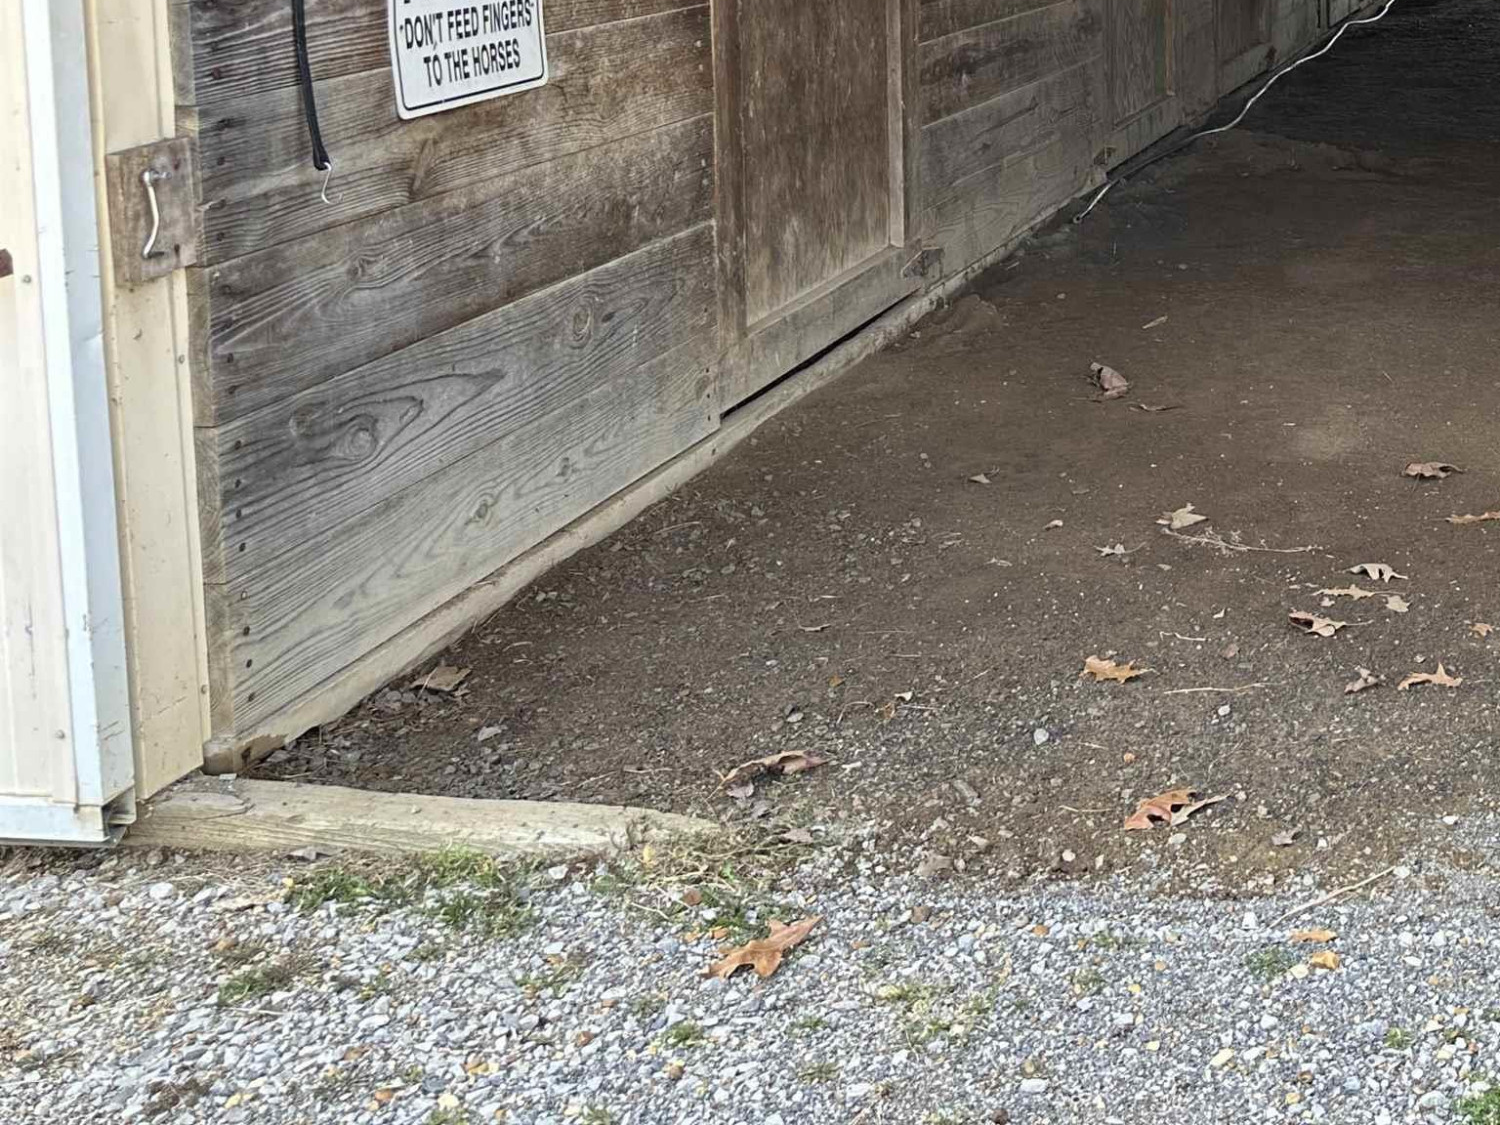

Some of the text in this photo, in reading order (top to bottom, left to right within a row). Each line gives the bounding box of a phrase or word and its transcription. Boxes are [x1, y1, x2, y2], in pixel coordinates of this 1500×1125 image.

[447, 6, 479, 42] FEED
[423, 38, 520, 88] TO THE HORSES
